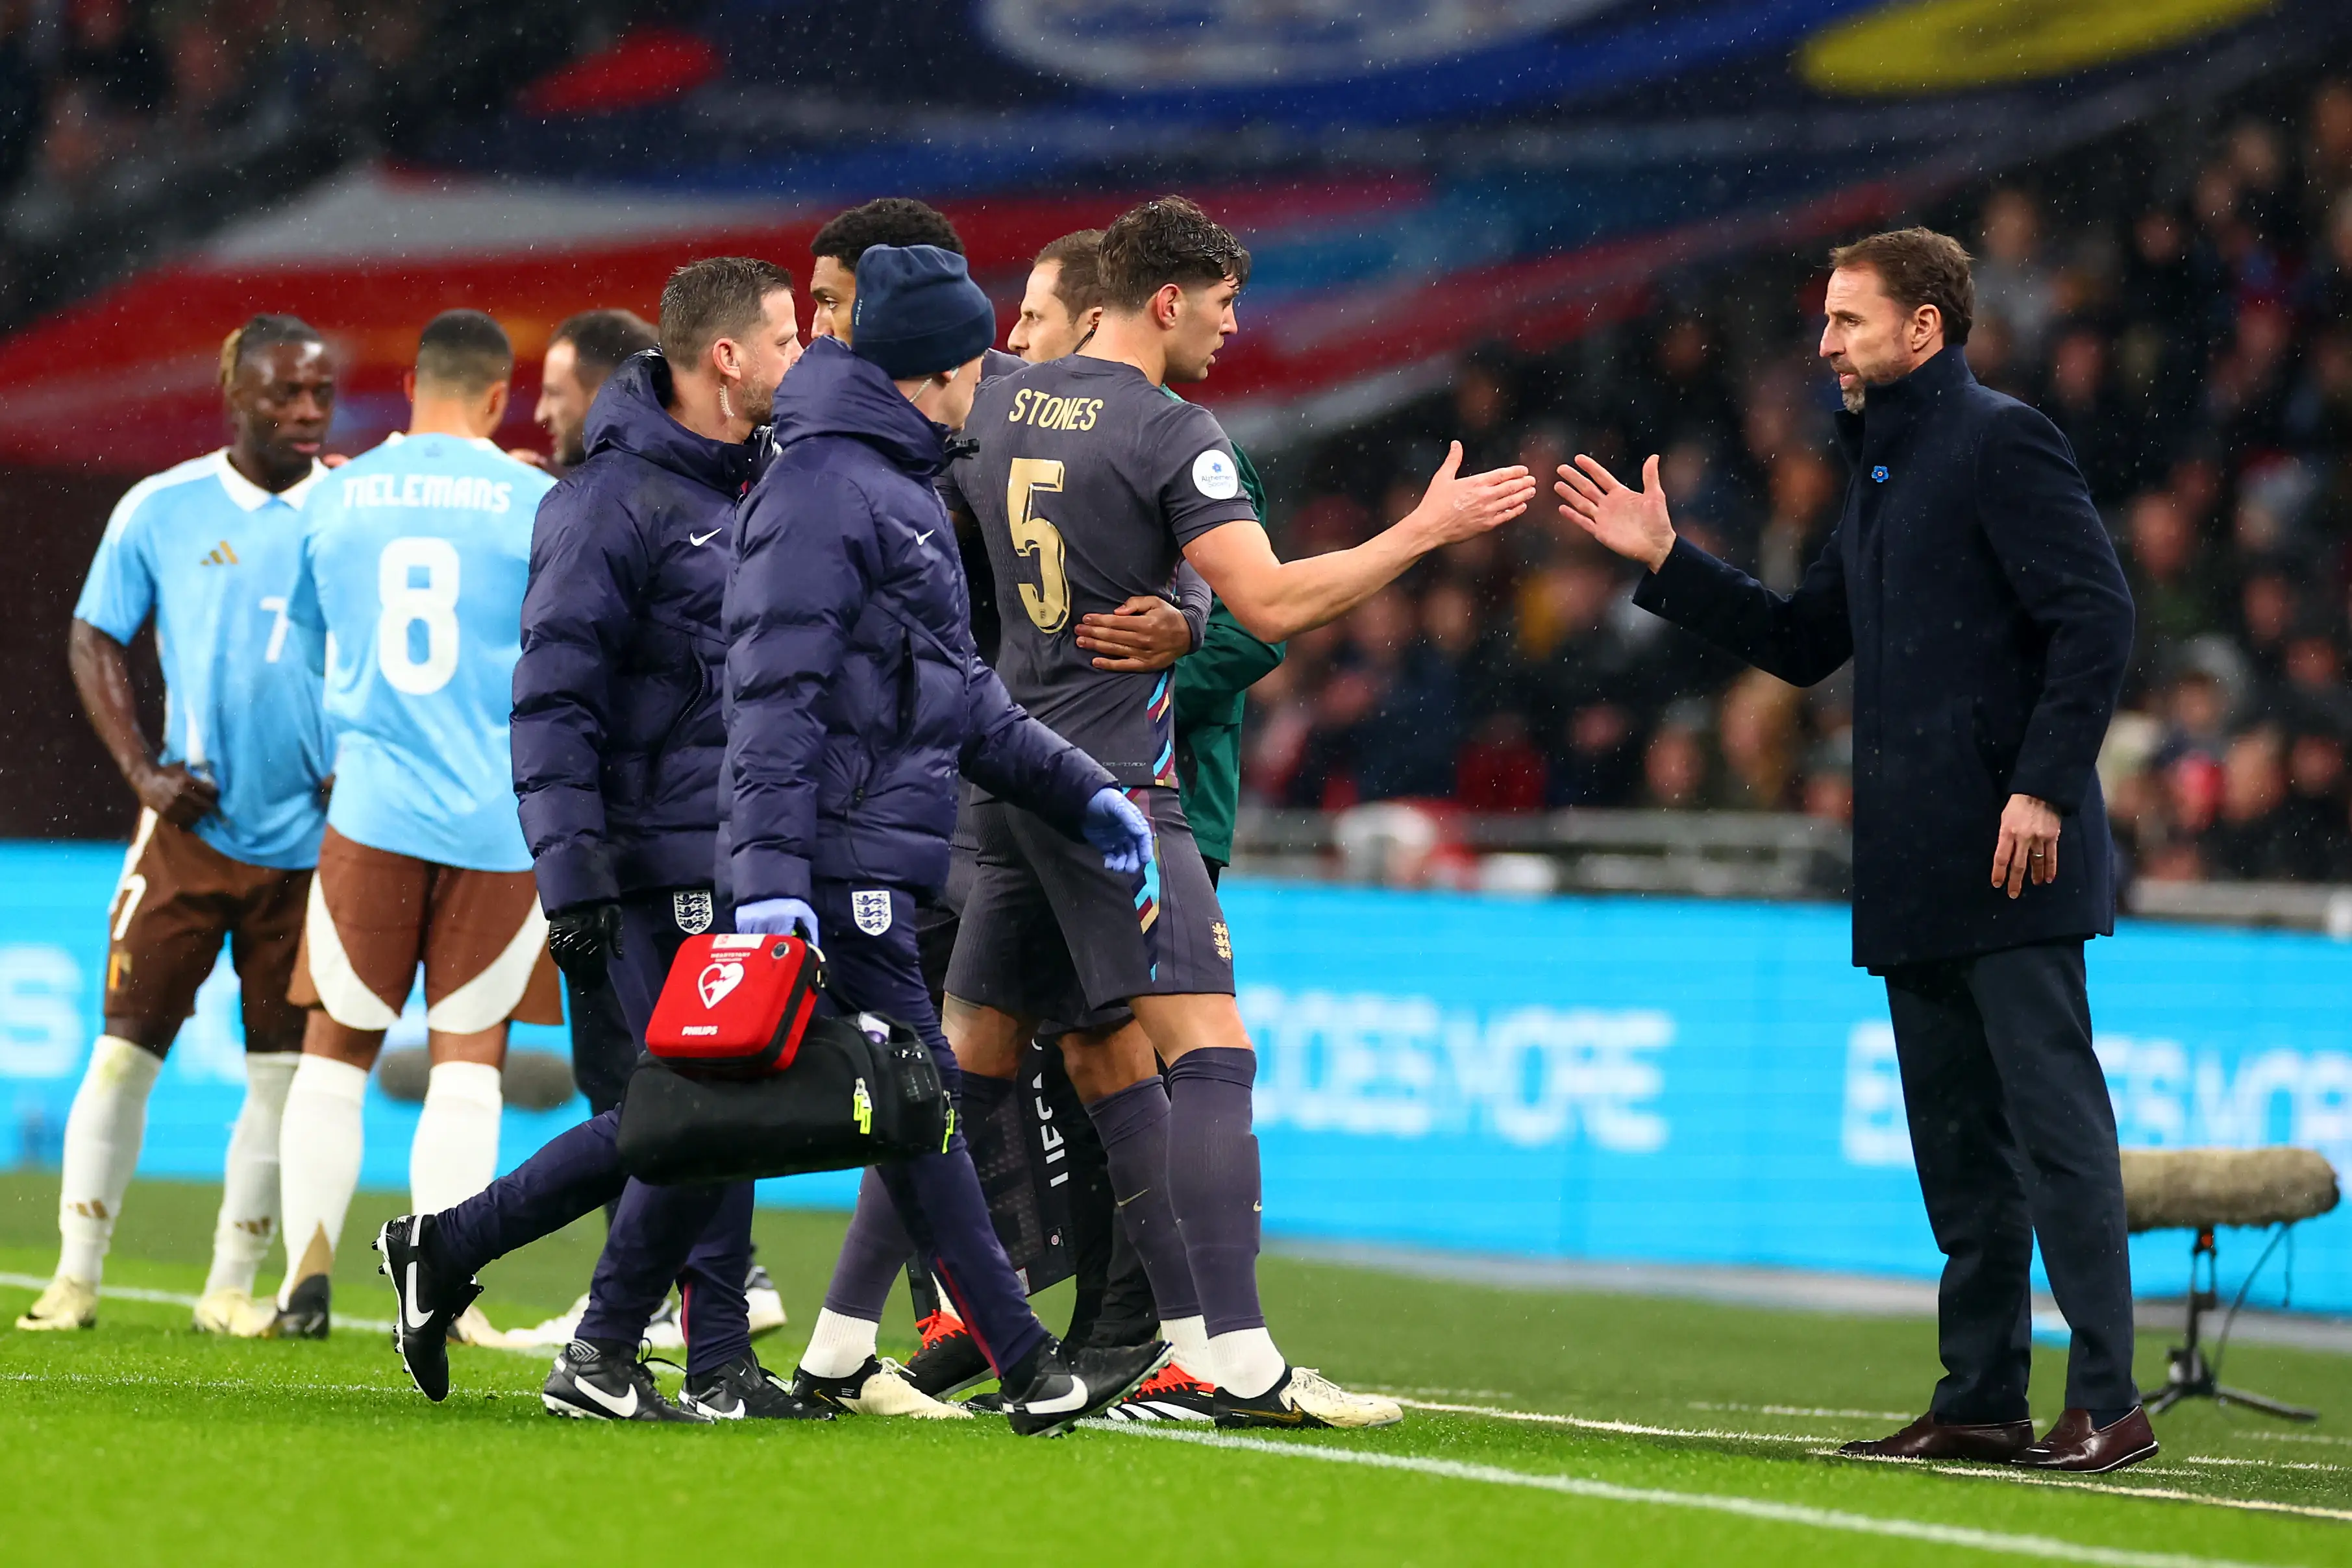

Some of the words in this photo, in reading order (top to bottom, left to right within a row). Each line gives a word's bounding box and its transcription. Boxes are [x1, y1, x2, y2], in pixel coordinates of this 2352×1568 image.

[1009, 388, 1103, 431] STONES
[343, 473, 513, 514] TIELEMANS
[1007, 457, 1071, 633] 5
[260, 597, 290, 664] 7
[378, 537, 460, 695] 8
[112, 874, 147, 941] 7
[681, 1025, 719, 1036] PHILIPS
